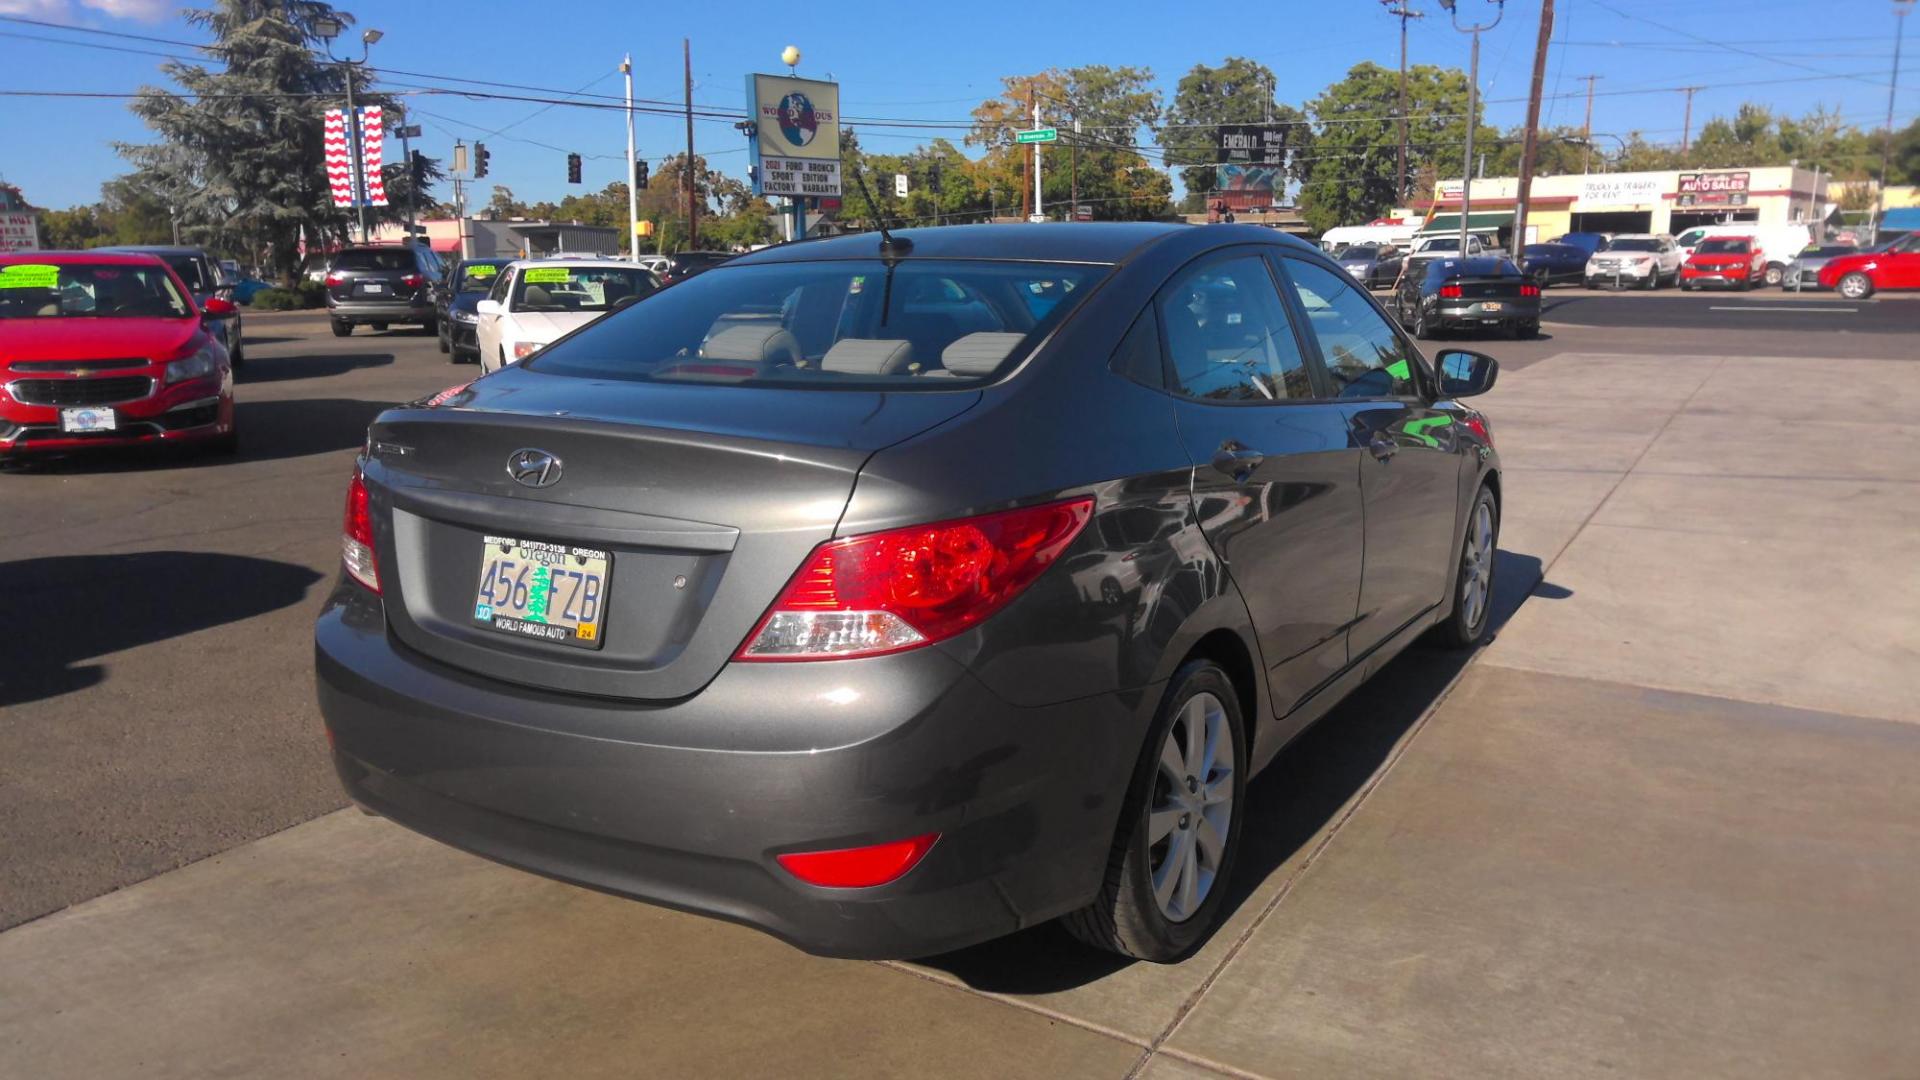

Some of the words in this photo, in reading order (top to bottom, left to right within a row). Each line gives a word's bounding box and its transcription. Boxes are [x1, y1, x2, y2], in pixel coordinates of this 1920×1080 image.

[786, 161, 803, 171] FORD
[808, 162, 835, 173] BRONCO
[771, 171, 794, 181] SPORT
[802, 173, 828, 183] EDITION
[764, 182, 796, 192] FACTORY
[802, 184, 838, 193] WARRANTY
[1682, 182, 1710, 192] AUTO
[1711, 180, 1745, 190] SALES
[483, 535, 517, 546] MEDFORD
[572, 547, 606, 560] OREGON
[520, 548, 566, 566] Oregon
[480, 559, 530, 610] 456
[546, 568, 601, 623] FZB
[495, 617, 518, 631] WORLD
[518, 621, 546, 637] FAMOUS
[546, 627, 566, 640] AUTO
[581, 629, 592, 638] 24
